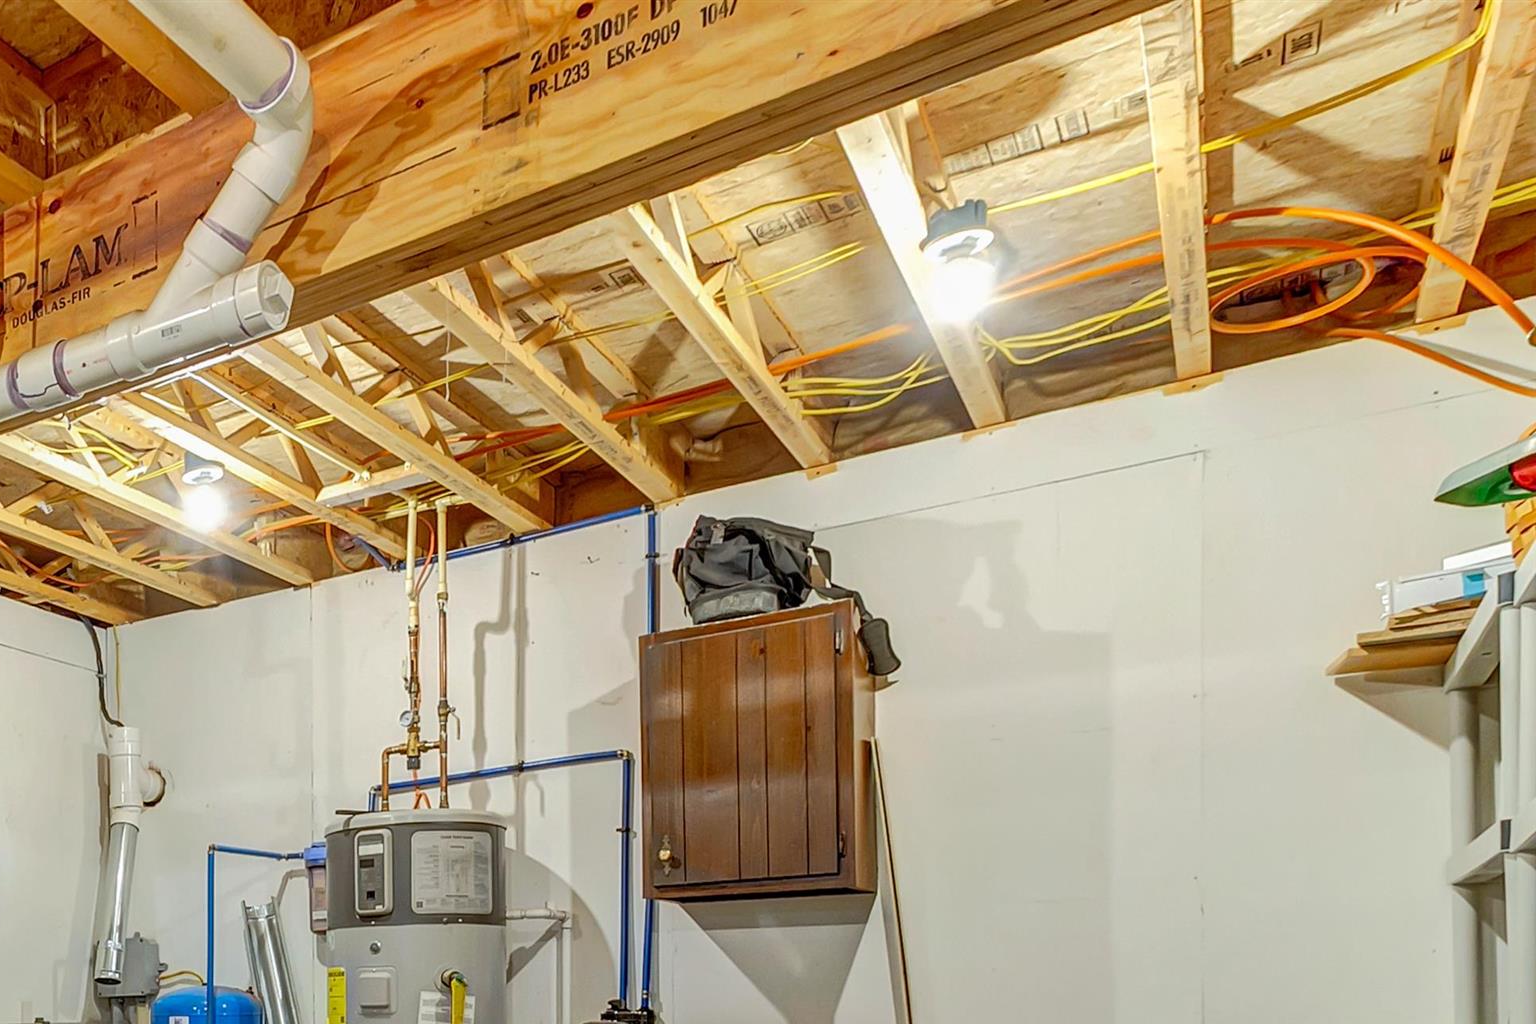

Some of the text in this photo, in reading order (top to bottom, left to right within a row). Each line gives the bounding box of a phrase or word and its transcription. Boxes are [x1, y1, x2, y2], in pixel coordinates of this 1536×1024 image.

[528, 60, 591, 104] PR-L233
[606, 19, 681, 70] ESR-2909
[530, 5, 640, 75] 2.0E-3100F
[12, 286, 91, 329] DOUGLAS-FIR
